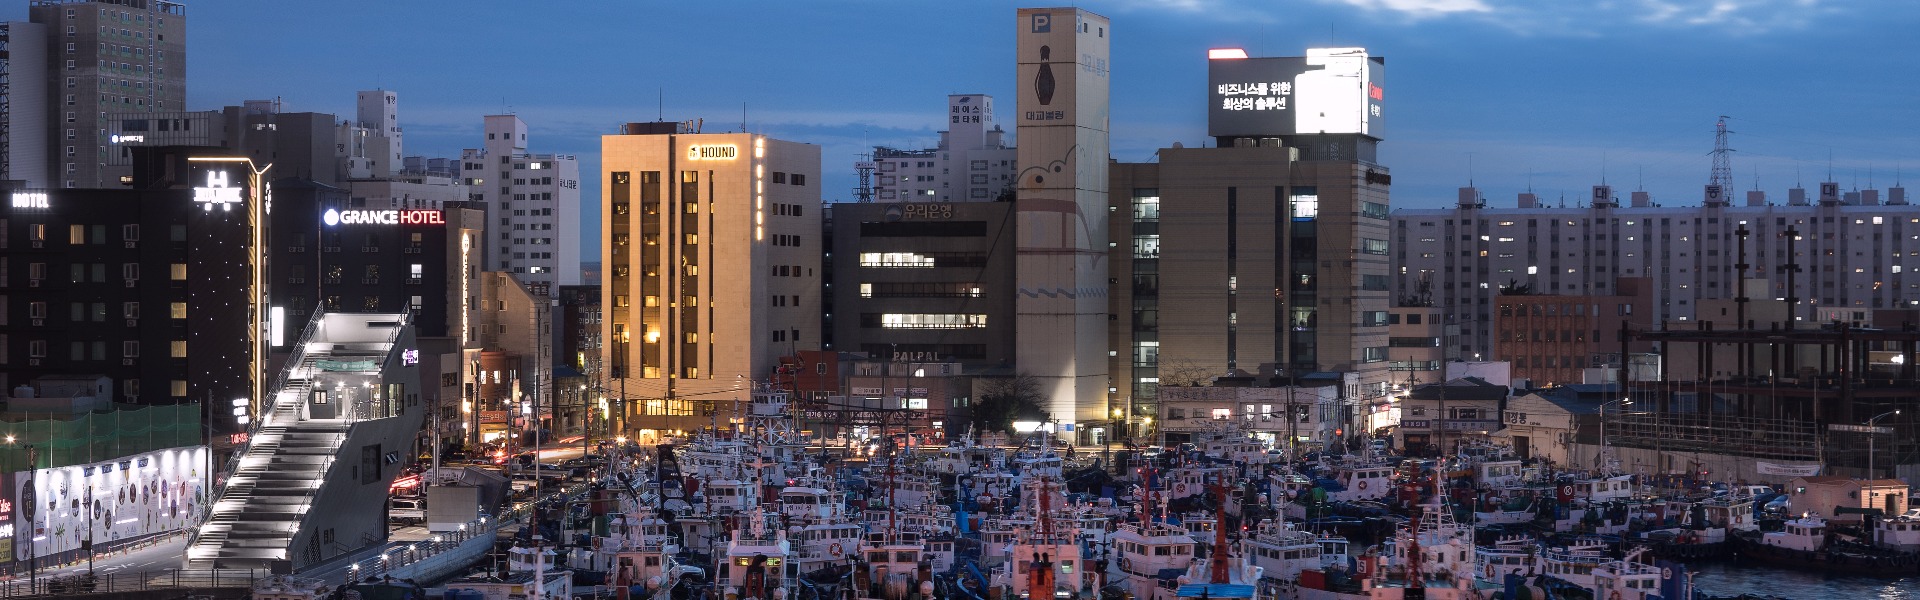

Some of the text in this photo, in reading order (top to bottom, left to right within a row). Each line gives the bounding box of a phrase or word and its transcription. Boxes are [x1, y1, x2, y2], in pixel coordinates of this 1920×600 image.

[1034, 15, 1049, 31] P
[1218, 81, 1291, 96] 비즈니스를 위한
[1222, 97, 1286, 111] 최상의 솔루션
[1026, 110, 1064, 120] 대교볼링
[701, 146, 735, 158] HOUND
[13, 193, 48, 208] HOTEL
[340, 210, 445, 225] GRANCE HOTEL
[905, 204, 952, 219] 우리은행
[893, 351, 940, 362] PALPAL
